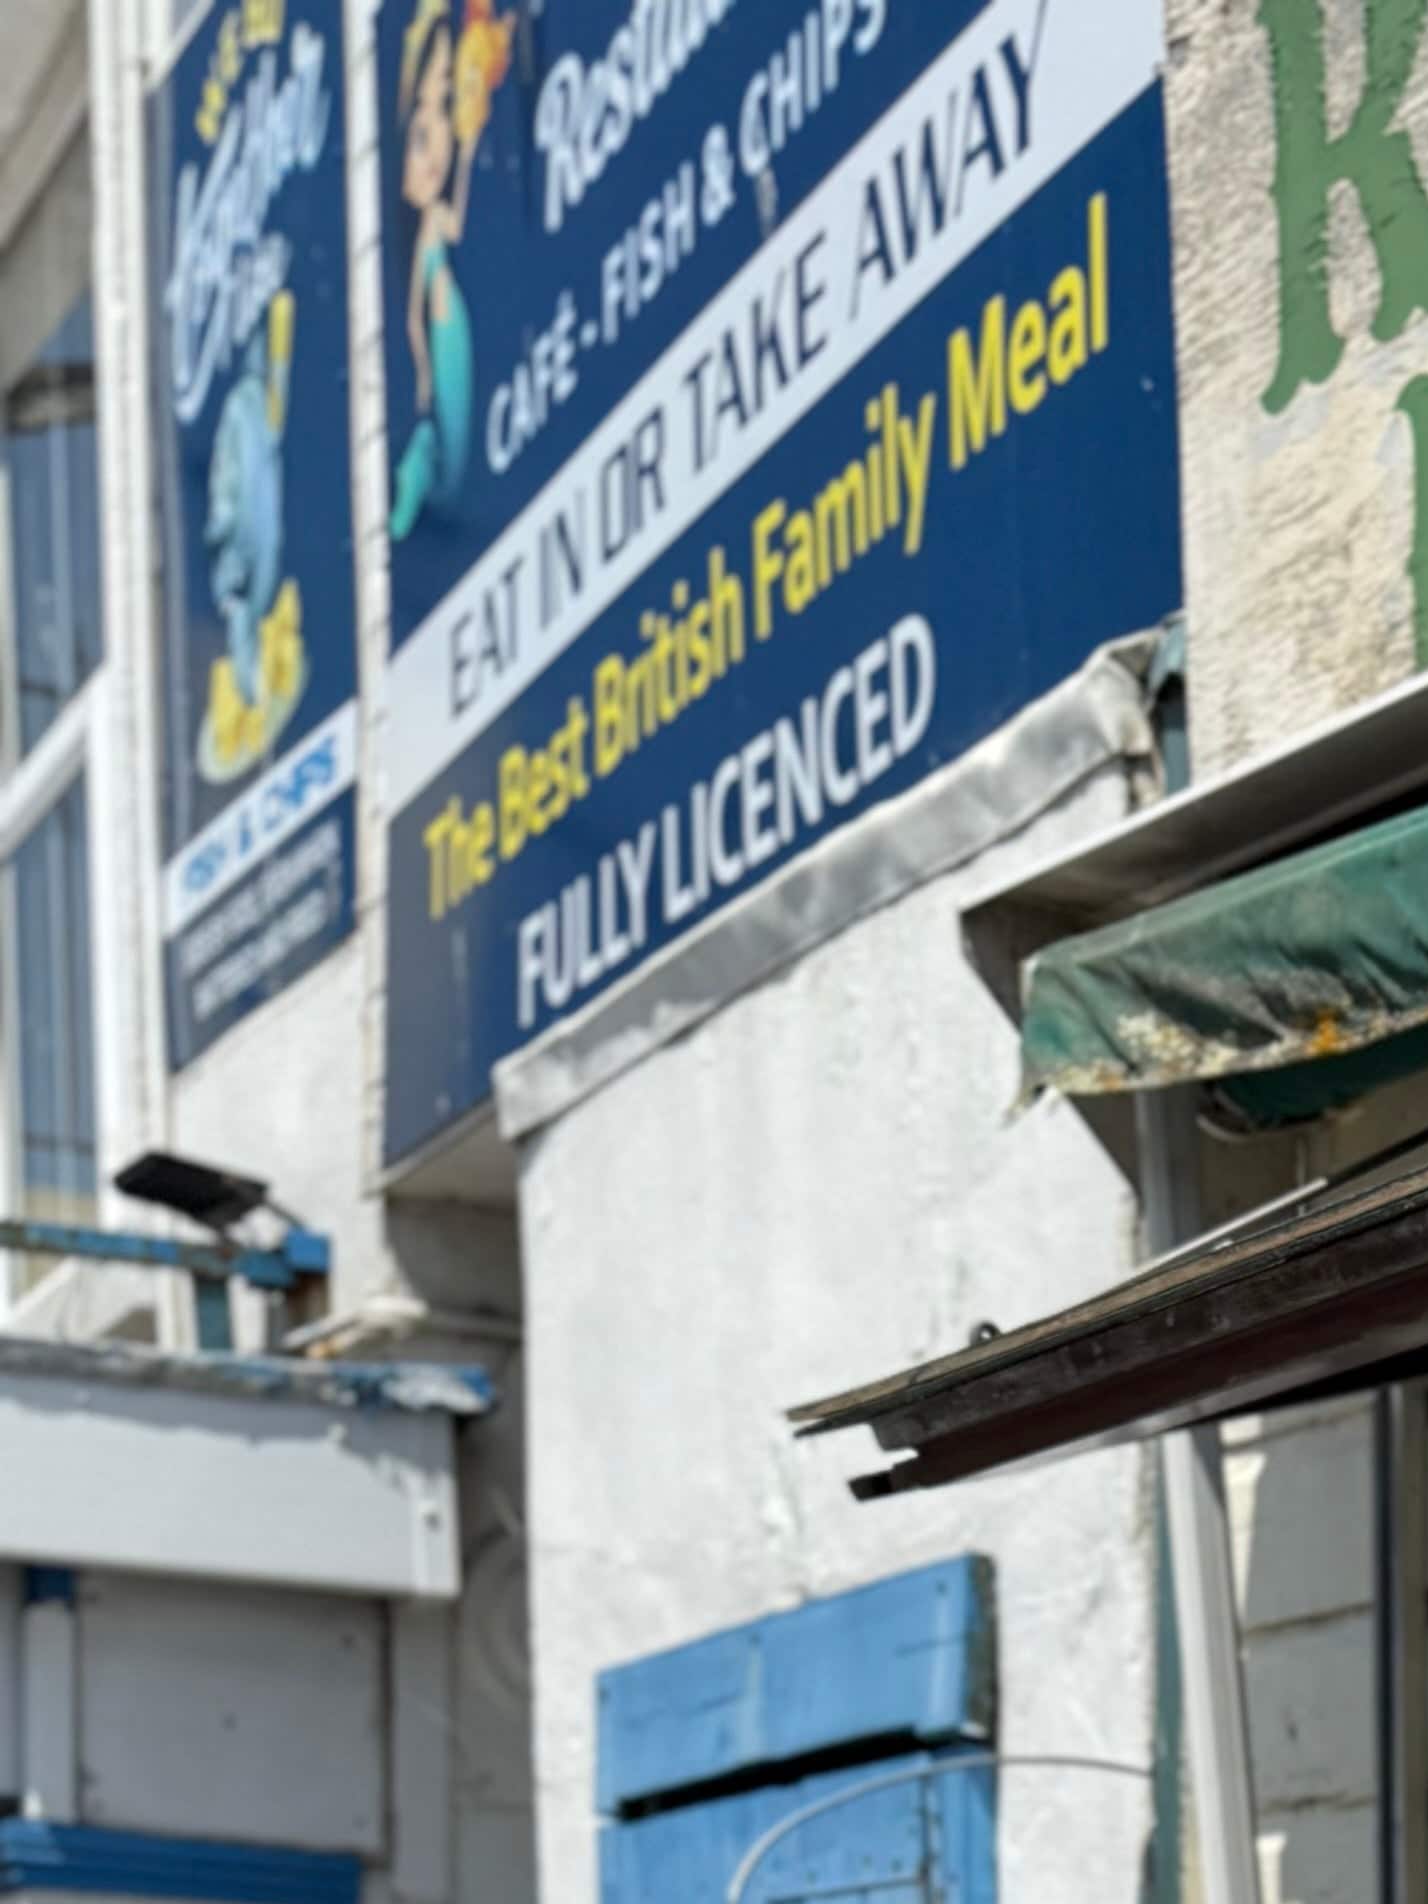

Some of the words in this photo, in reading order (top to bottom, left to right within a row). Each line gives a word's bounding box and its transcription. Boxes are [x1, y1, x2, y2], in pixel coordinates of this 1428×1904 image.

[450, 555, 523, 720] EAT
[539, 487, 586, 633] IN
[600, 403, 667, 566] OR
[682, 229, 829, 476] TAKE
[848, 0, 1048, 324] AWAY
[602, 160, 695, 346] FISH
[702, 122, 736, 228] &
[740, 0, 887, 177] CHIPS
[423, 795, 497, 921] The
[499, 697, 590, 861] Best
[593, 545, 745, 779] British
[751, 380, 936, 642] Family
[947, 191, 1109, 472] Meal
[516, 821, 657, 1031] FULLY
[660, 612, 937, 926] LICENCED
